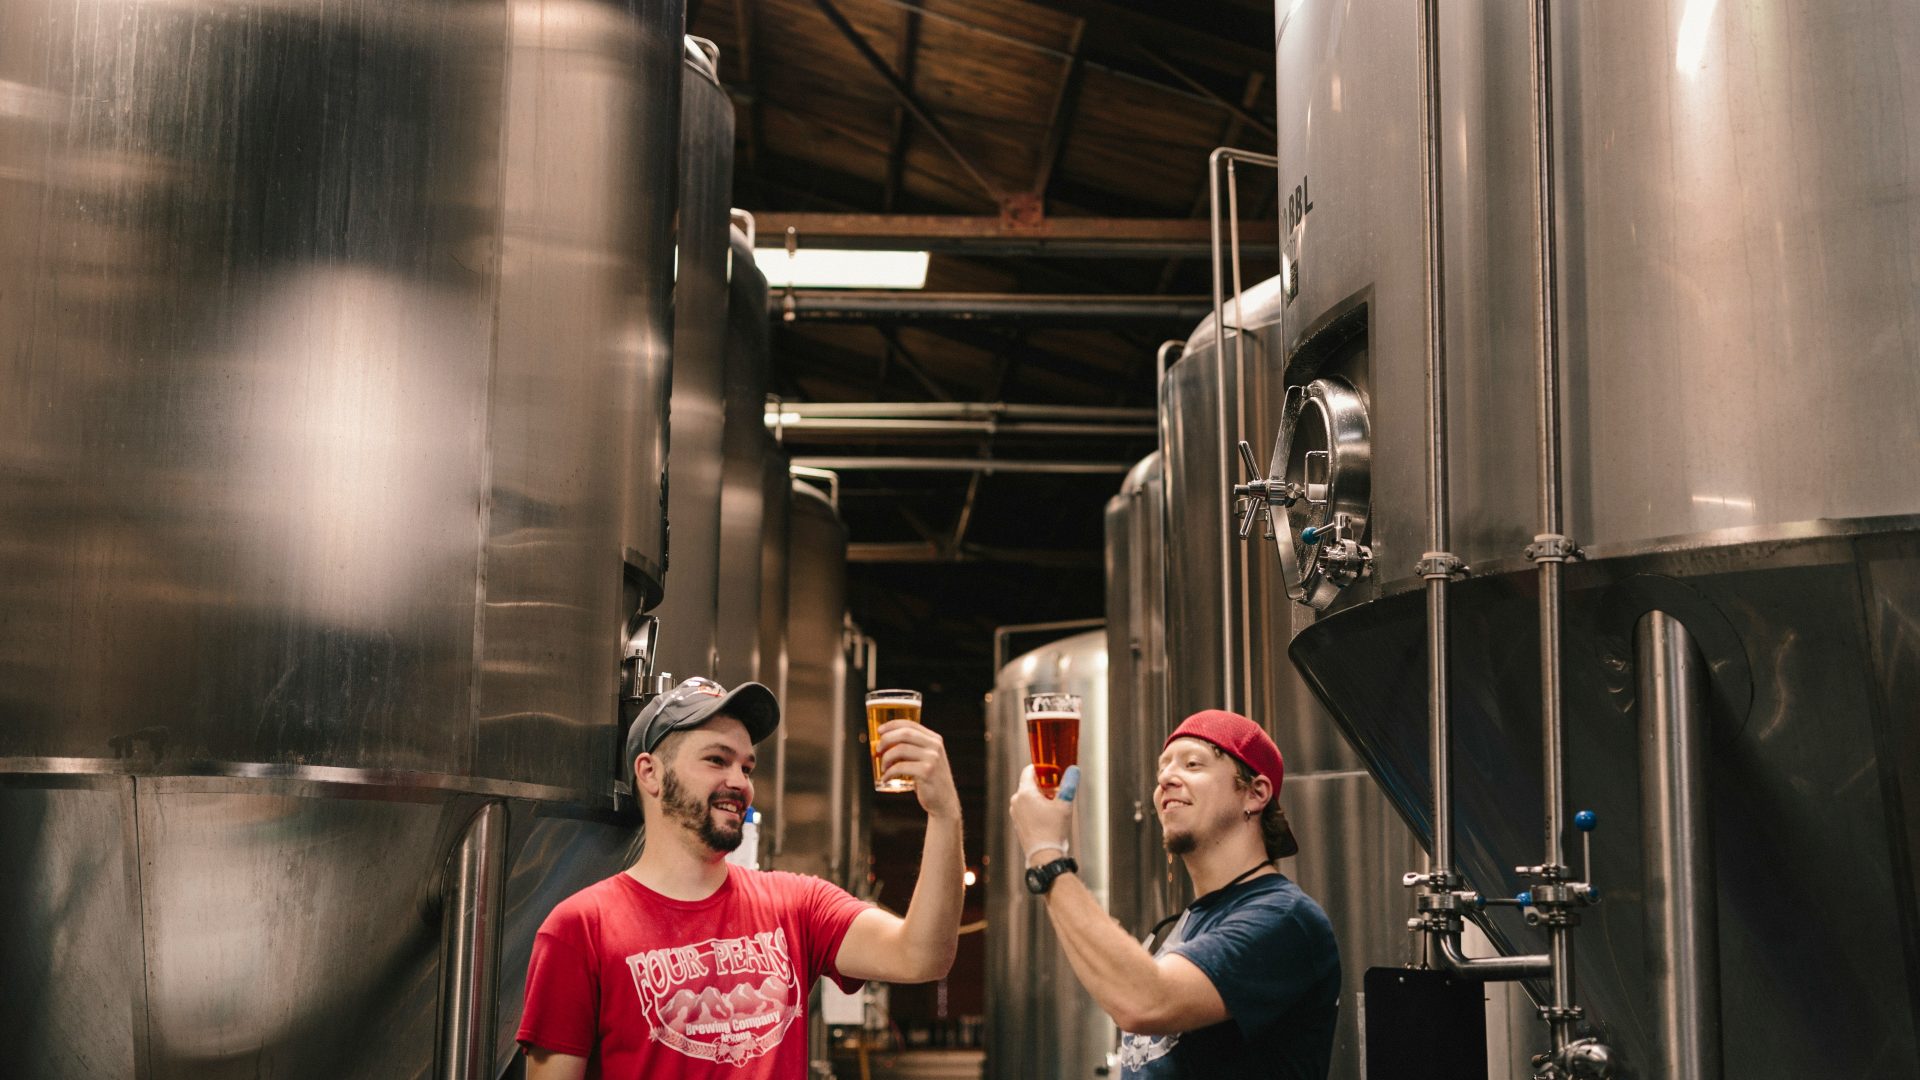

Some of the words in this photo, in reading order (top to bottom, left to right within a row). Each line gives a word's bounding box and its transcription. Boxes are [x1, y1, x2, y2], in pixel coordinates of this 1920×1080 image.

[626, 948, 709, 1016] FOUR
[685, 1021, 731, 1036] Brewing
[732, 1011, 781, 1032] Company
[720, 1031, 752, 1043] Arizona
